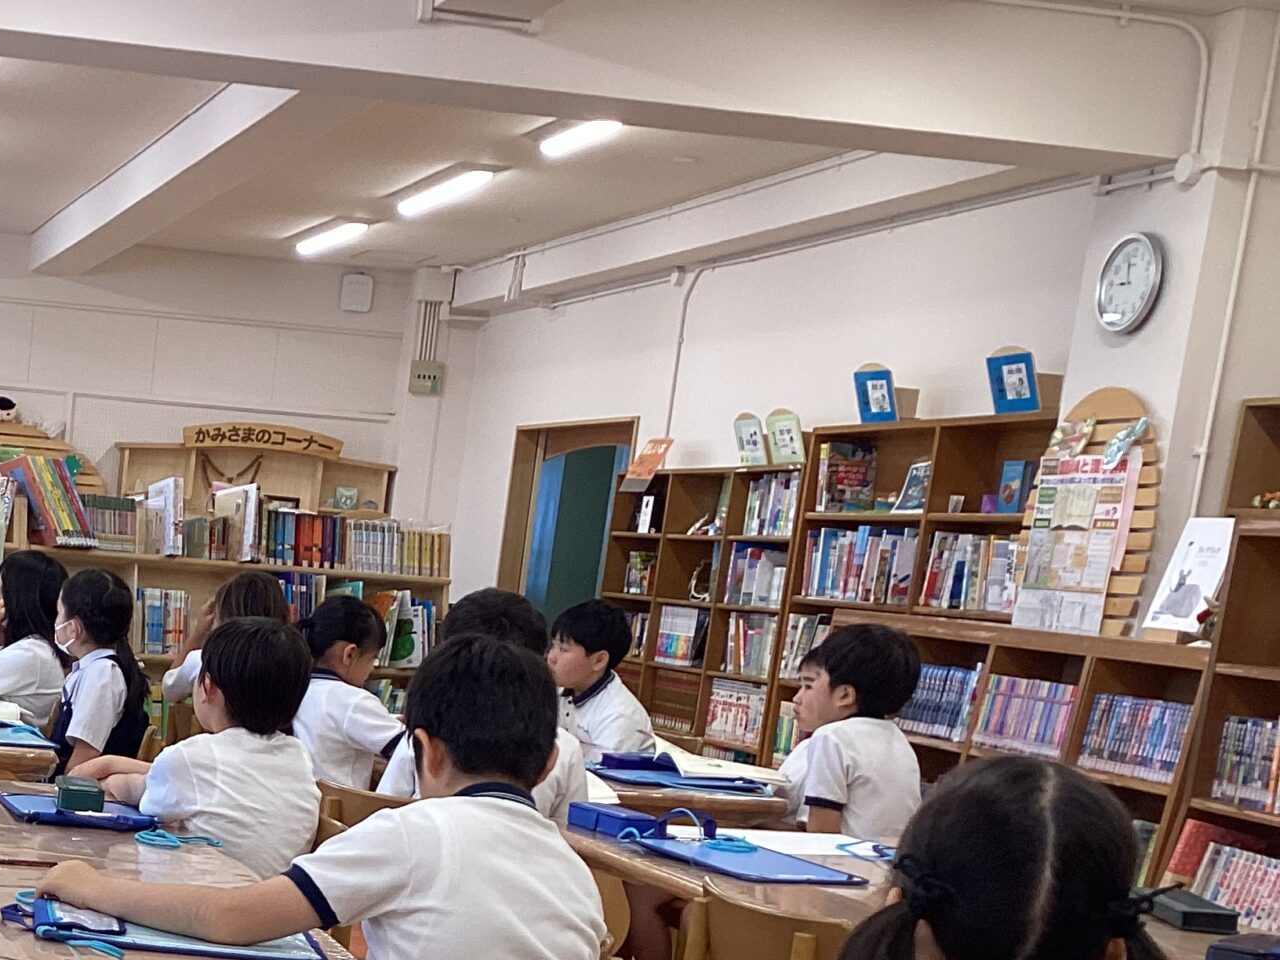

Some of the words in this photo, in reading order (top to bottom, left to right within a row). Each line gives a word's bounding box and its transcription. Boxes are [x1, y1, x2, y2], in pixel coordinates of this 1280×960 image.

[194, 426, 334, 451] かみさまのコーナー
